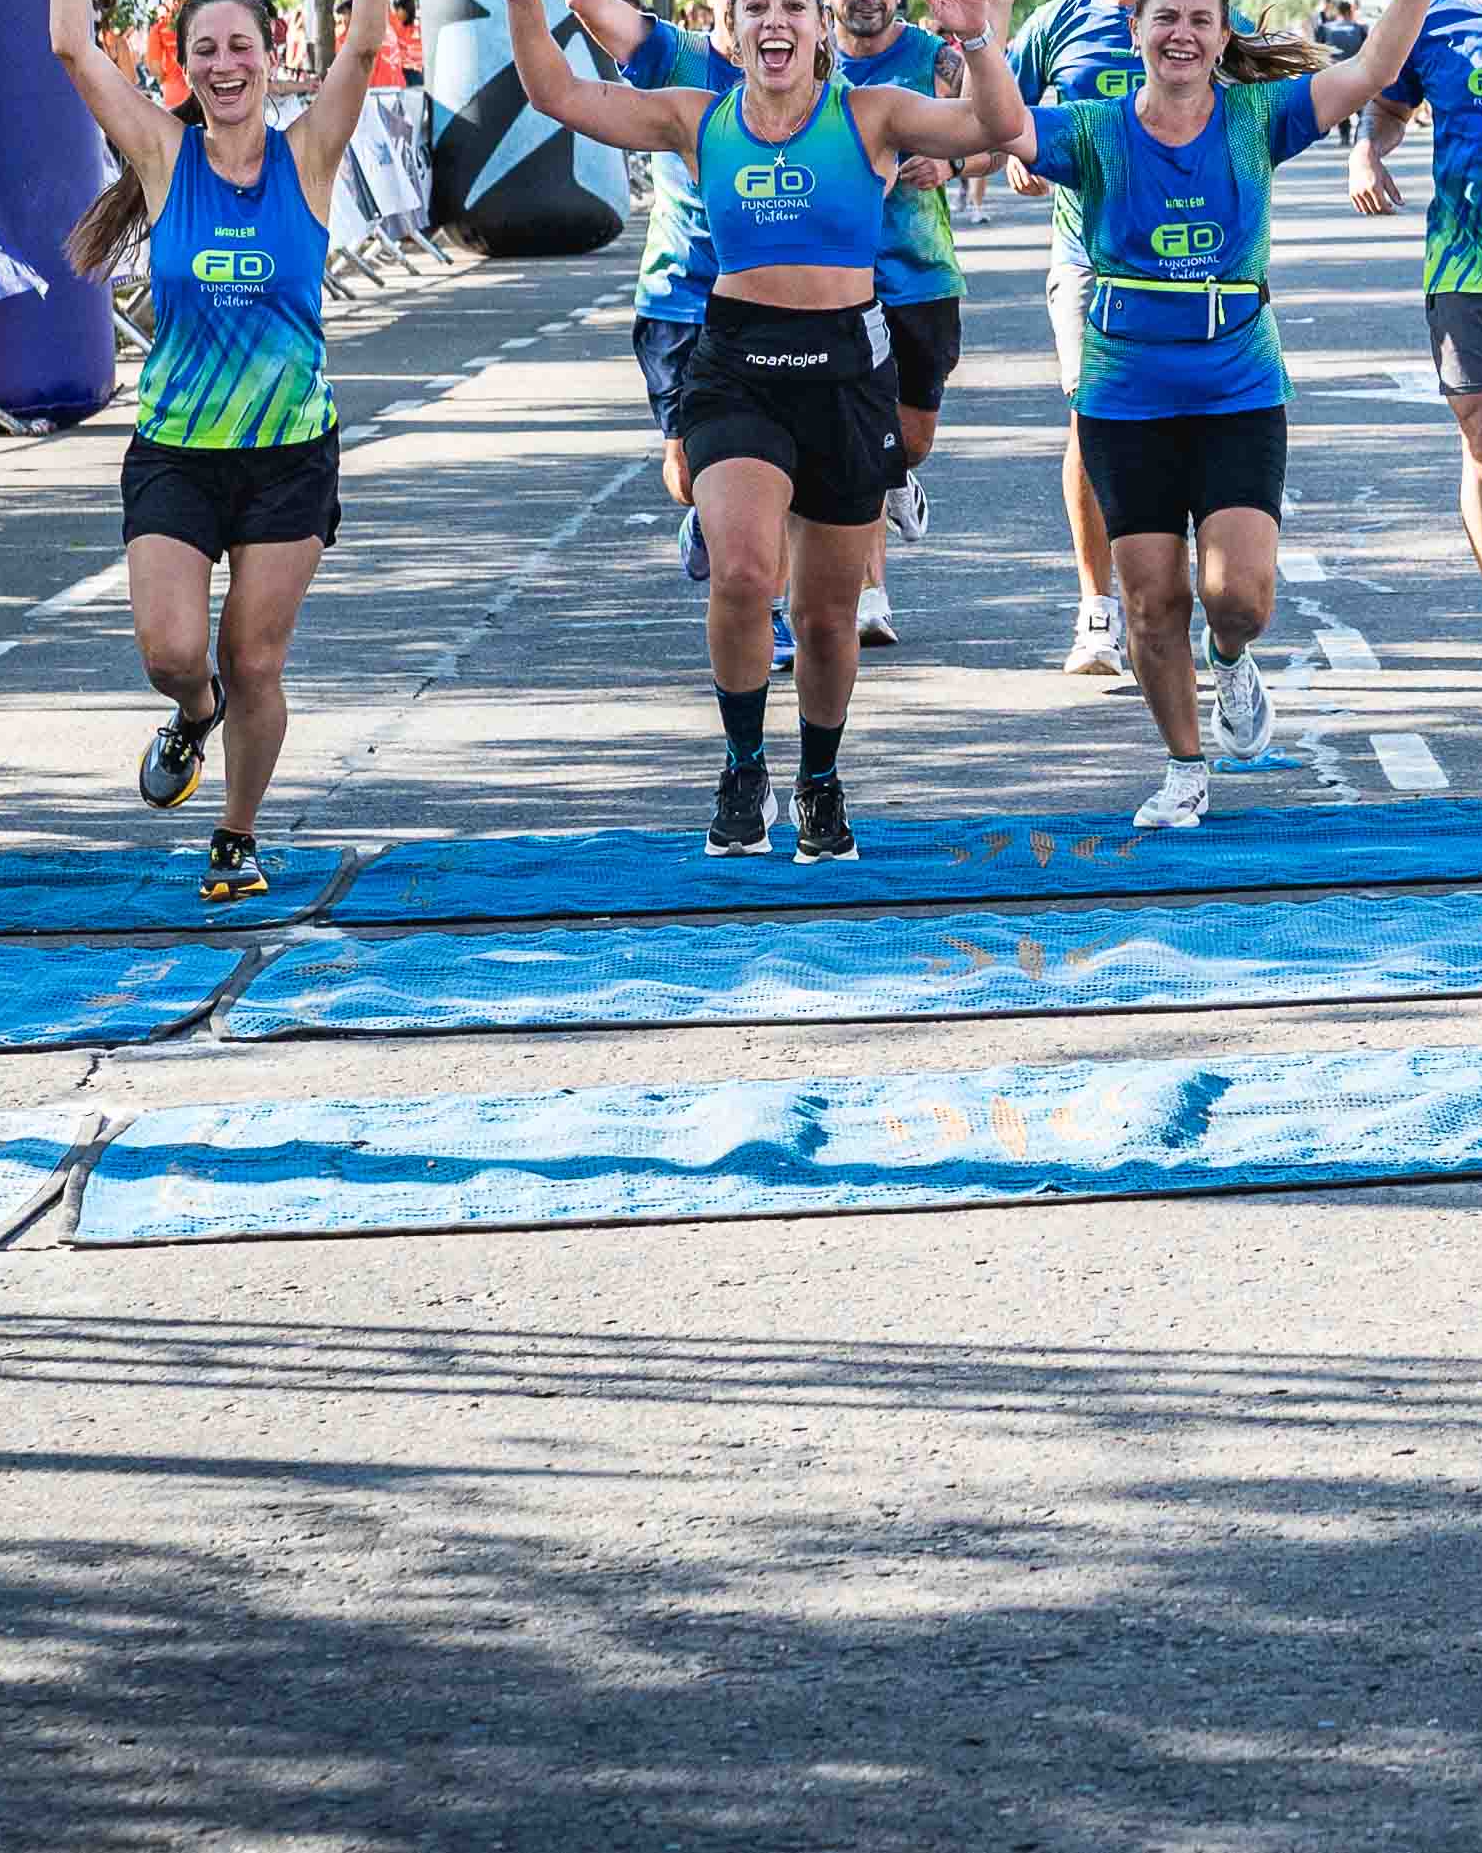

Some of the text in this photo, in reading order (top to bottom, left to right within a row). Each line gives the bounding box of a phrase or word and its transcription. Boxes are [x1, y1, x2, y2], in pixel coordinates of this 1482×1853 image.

[741, 198, 811, 210] FUNCIONAL
[1165, 195, 1205, 208] HARLEM
[755, 209, 799, 225] Outdoor
[1158, 255, 1220, 268] FUNCIONAL
[200, 283, 264, 293] FUNCIONAL
[746, 353, 829, 368] noaflojes
